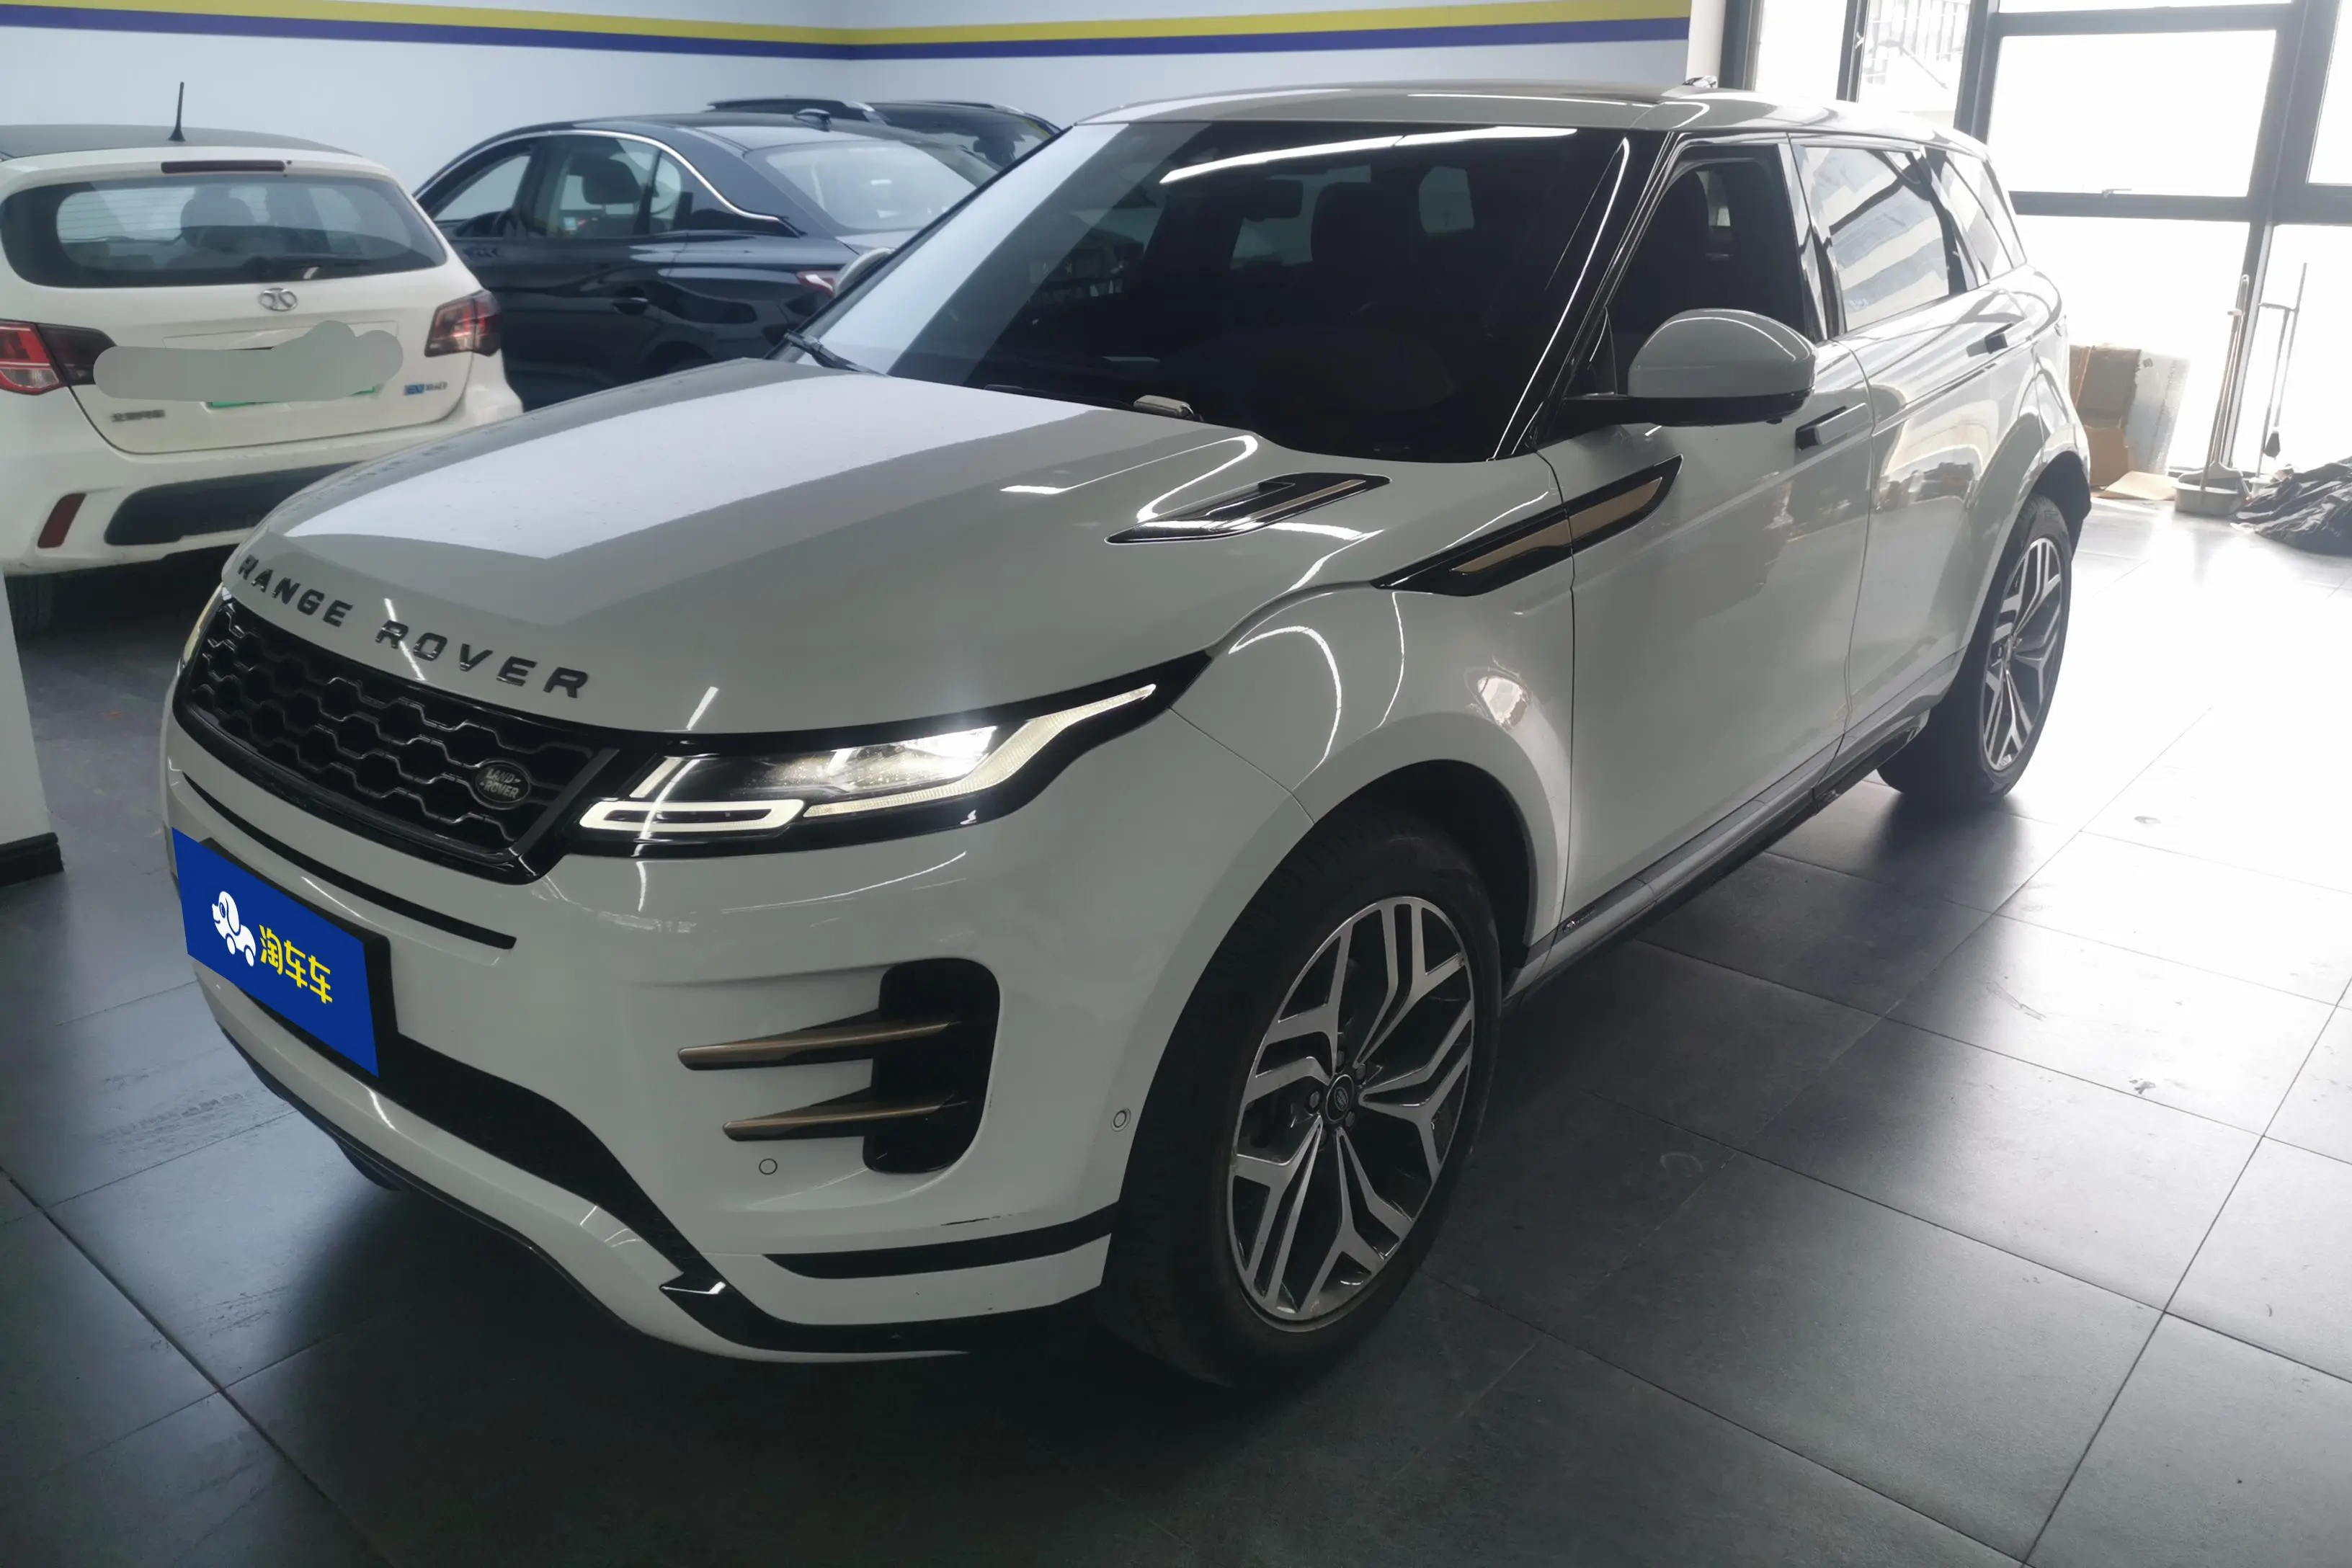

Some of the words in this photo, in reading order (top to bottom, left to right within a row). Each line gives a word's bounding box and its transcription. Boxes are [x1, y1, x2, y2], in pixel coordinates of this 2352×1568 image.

[237, 554, 353, 628] RANGE
[375, 620, 589, 699] ROVER
[486, 768, 515, 783] LAND
[484, 780, 520, 798] ROVER
